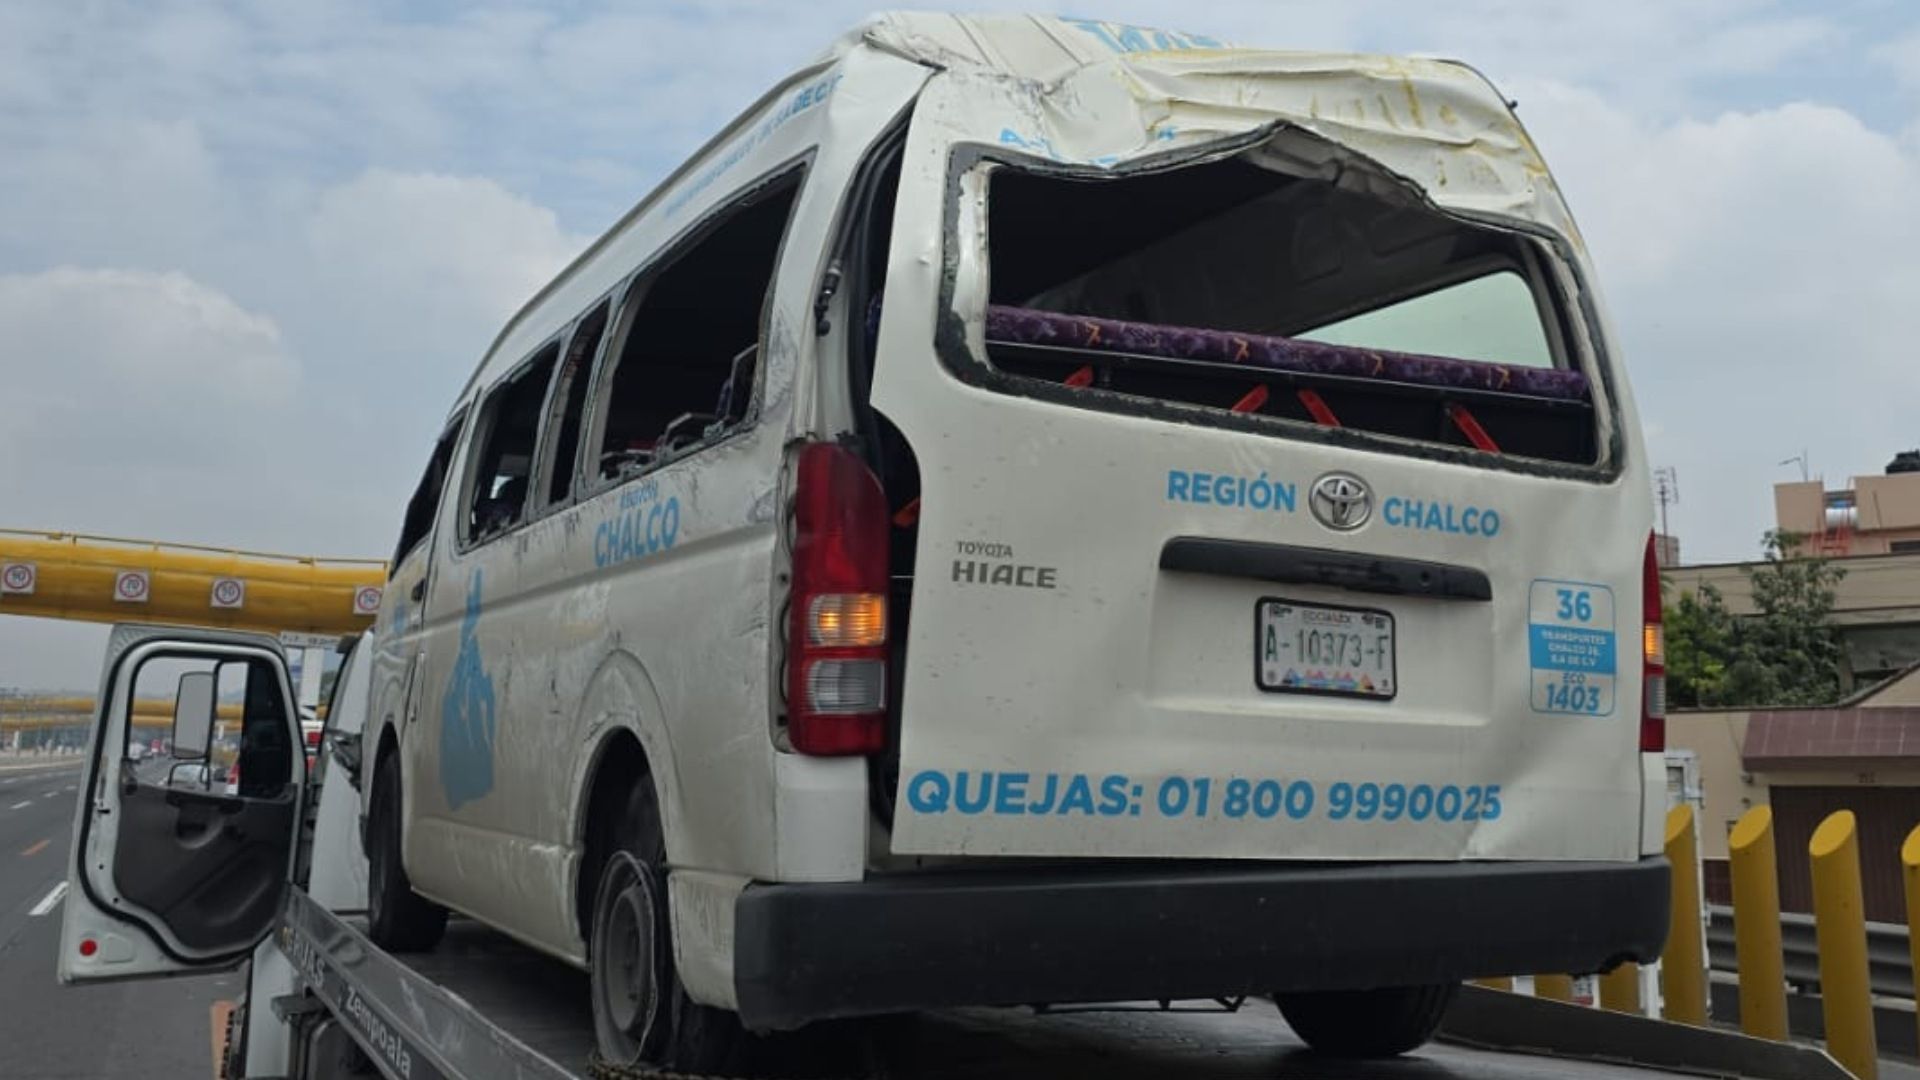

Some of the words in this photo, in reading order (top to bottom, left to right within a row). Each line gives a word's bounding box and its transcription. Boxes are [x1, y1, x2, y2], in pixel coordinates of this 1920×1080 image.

[1167, 471, 1297, 513] REGIÓN
[593, 496, 680, 568] CHALCO
[1382, 496, 1500, 537] CHALCO
[957, 541, 1013, 558] TOYOTA
[951, 560, 1058, 589] HIACE
[1555, 589, 1593, 622] 36
[1265, 623, 1390, 671] A-10373-F
[1545, 683, 1600, 712] 1403
[1562, 671, 1587, 686] ECO
[906, 769, 1143, 816] QUEJAS:
[1157, 776, 1211, 817] 01
[1222, 778, 1315, 818] 800
[1327, 781, 1503, 822] 9990025
[345, 985, 412, 1080] Zempoala
